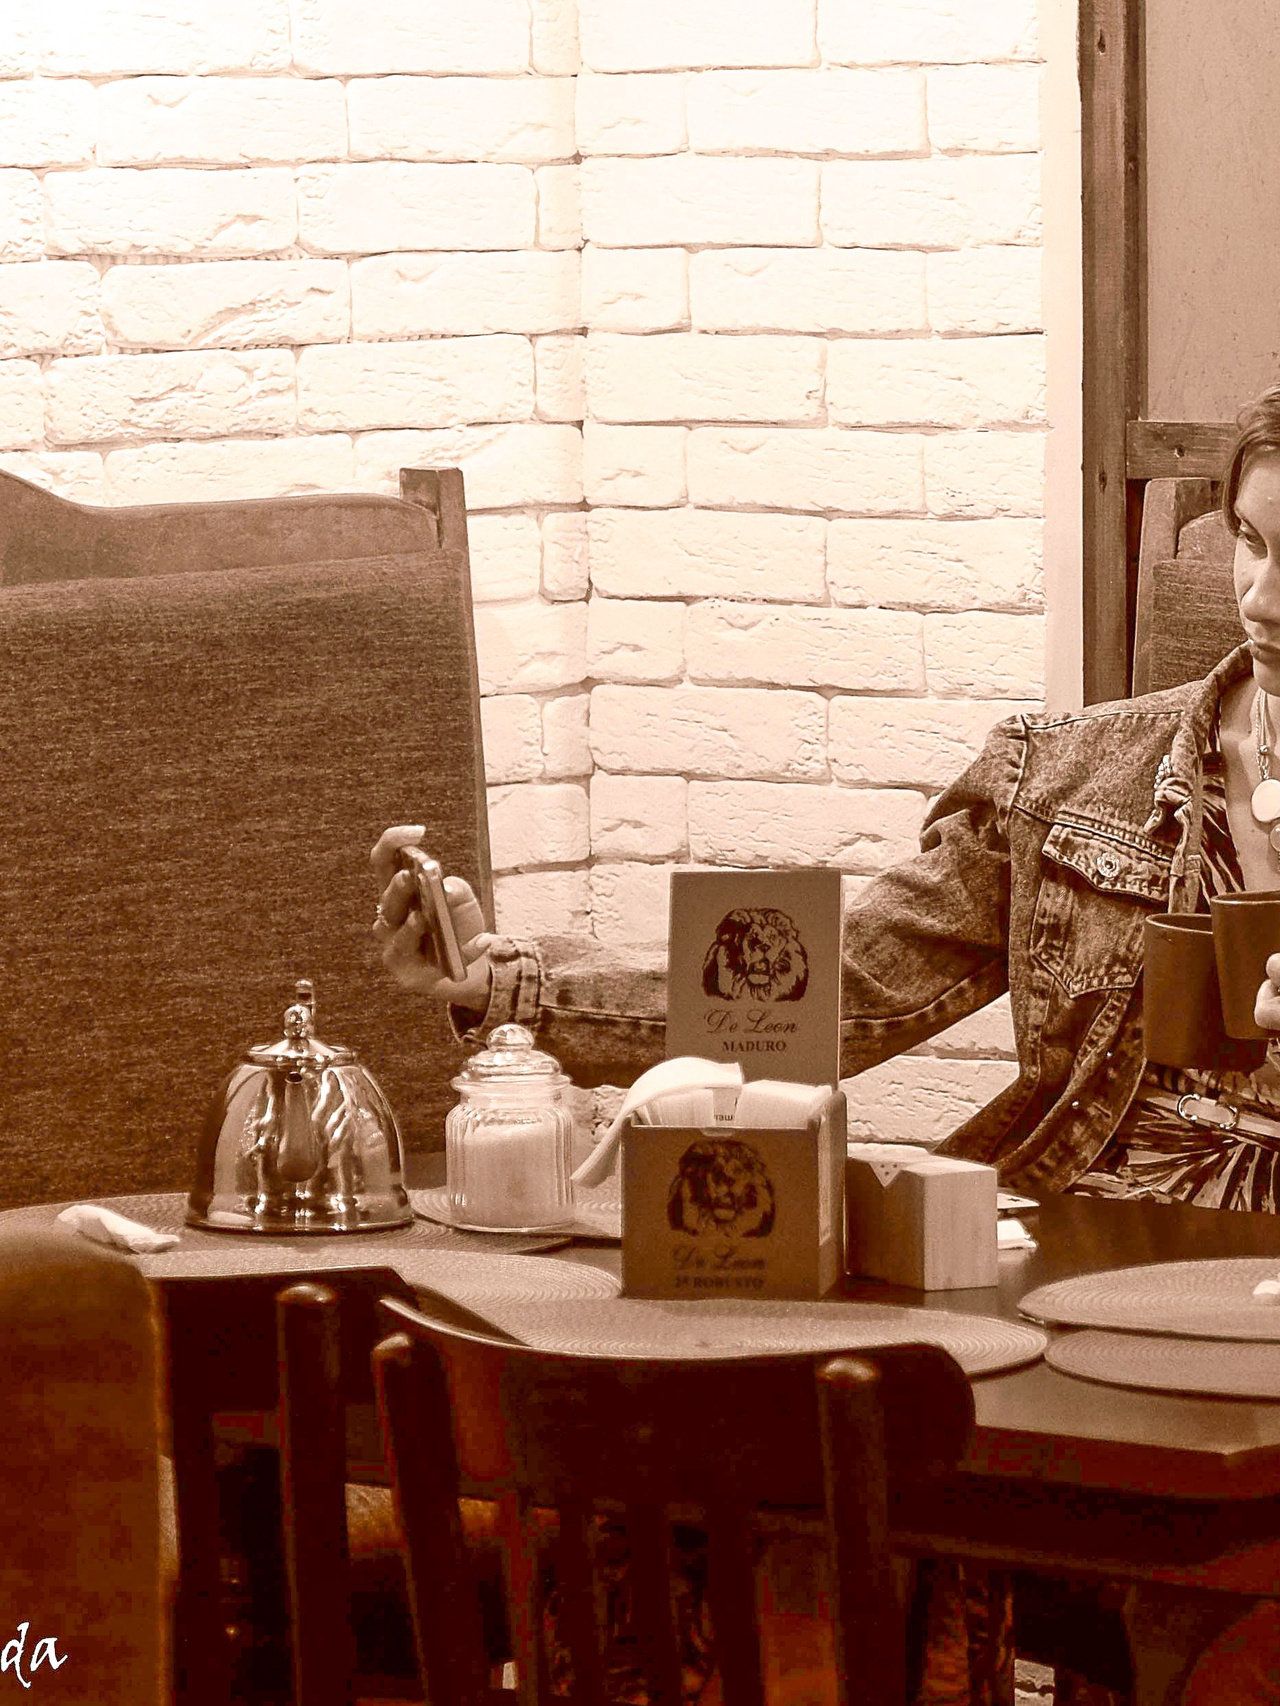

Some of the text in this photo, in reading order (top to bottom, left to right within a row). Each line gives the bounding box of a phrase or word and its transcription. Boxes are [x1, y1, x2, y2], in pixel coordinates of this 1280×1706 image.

[703, 1009, 798, 1033] De Leon
[722, 1041, 787, 1052] MADURO
